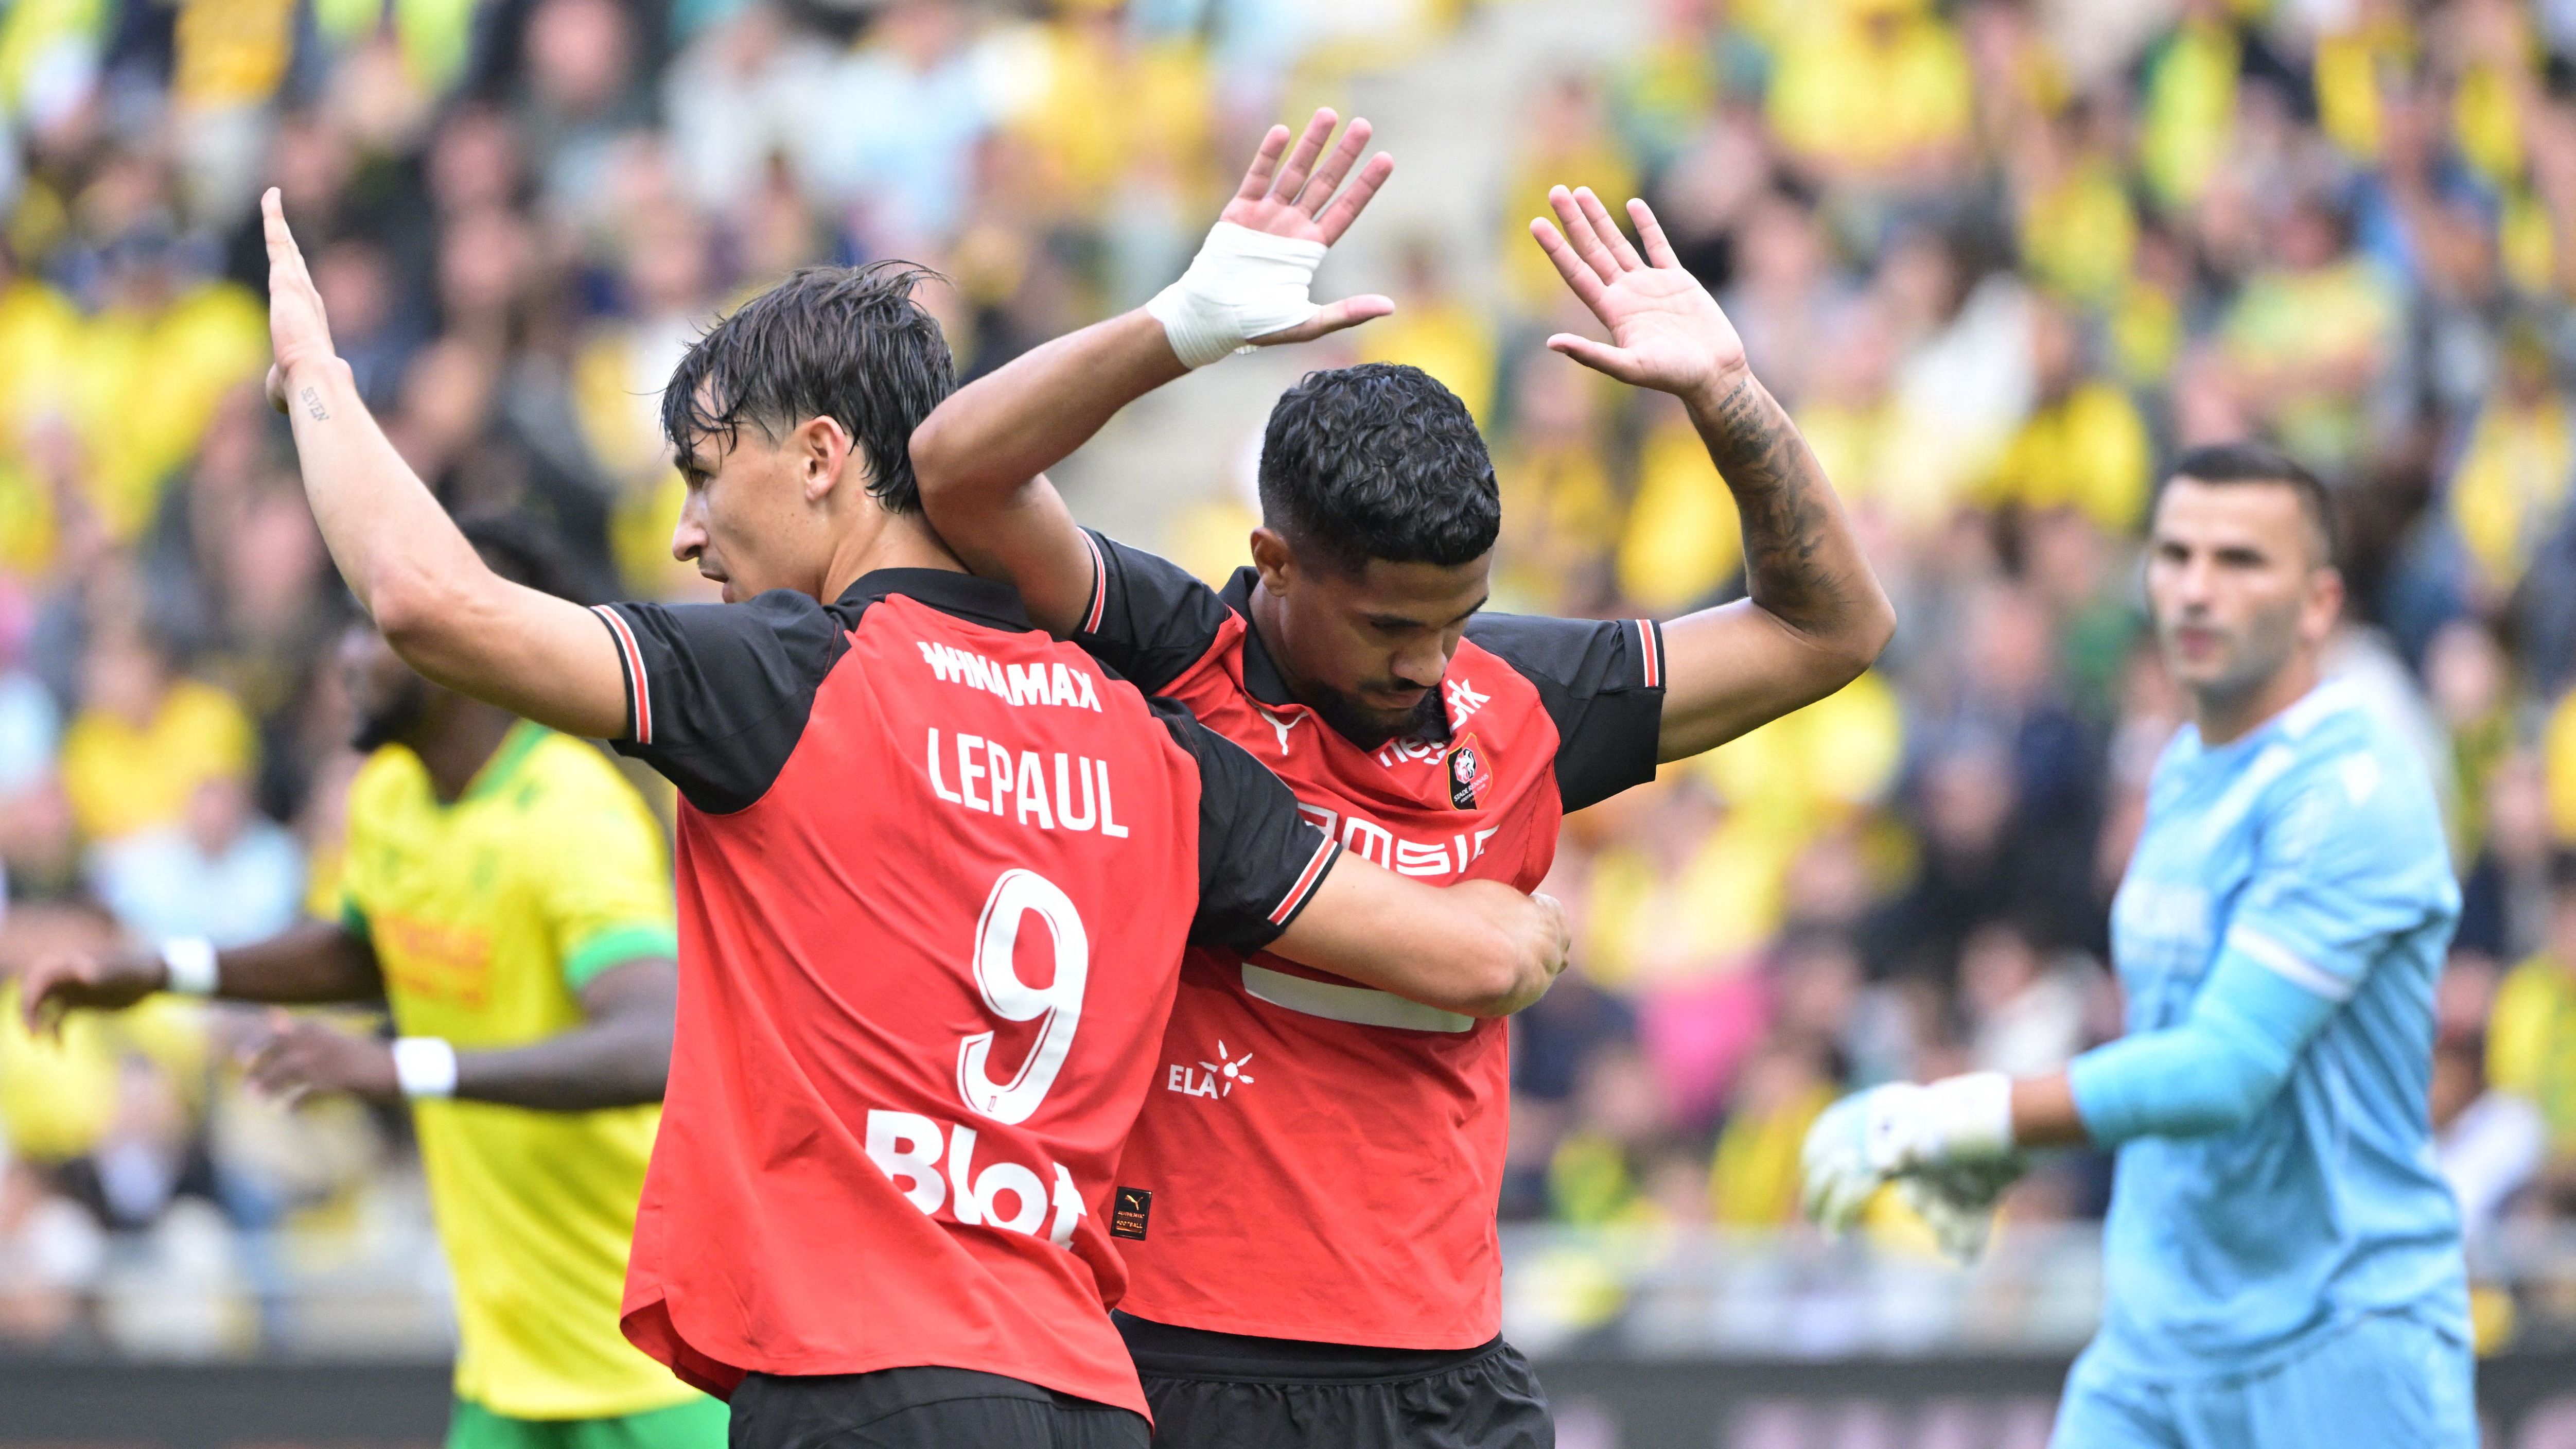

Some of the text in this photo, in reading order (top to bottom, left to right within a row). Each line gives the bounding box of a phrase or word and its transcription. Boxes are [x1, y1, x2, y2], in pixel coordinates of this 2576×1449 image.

[302, 387, 329, 421] SEVEN
[917, 642, 1102, 712] WINAMAX
[928, 727, 1129, 838] LEPAUL
[1454, 788, 1469, 801] STADE
[1468, 773, 1488, 791] RENNAIS
[956, 868, 1089, 1125] 9
[1167, 1065, 1218, 1100] ELA
[865, 1109, 1088, 1251] Blot
